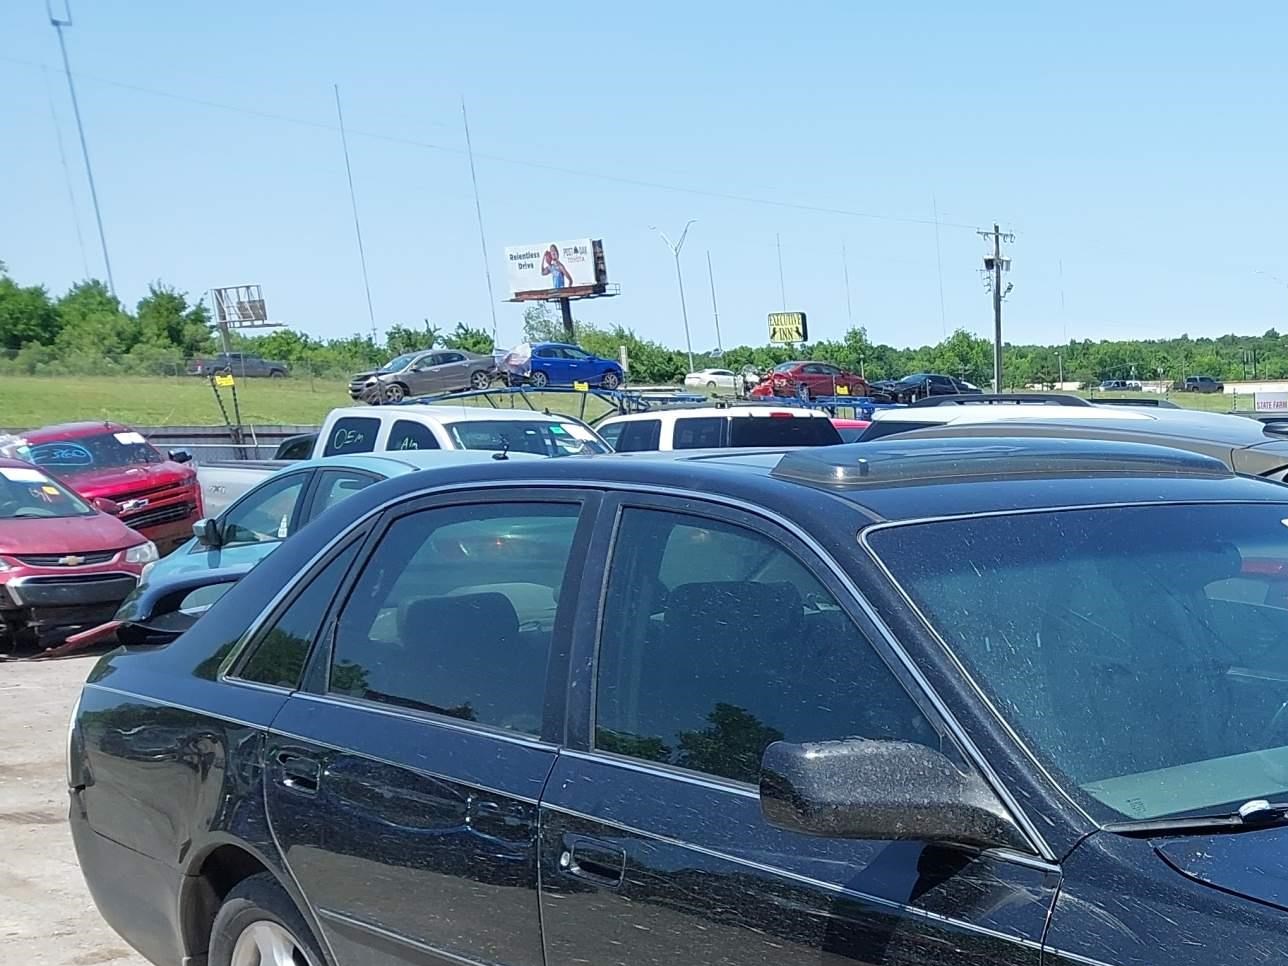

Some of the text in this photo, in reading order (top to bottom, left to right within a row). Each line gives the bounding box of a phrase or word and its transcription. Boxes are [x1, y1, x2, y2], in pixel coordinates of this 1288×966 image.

[509, 251, 541, 263] Relentless
[518, 261, 535, 270] Drive
[769, 314, 801, 327] EXECUTIVE
[779, 327, 794, 341] INN
[1256, 400, 1288, 410] STATE FARM
